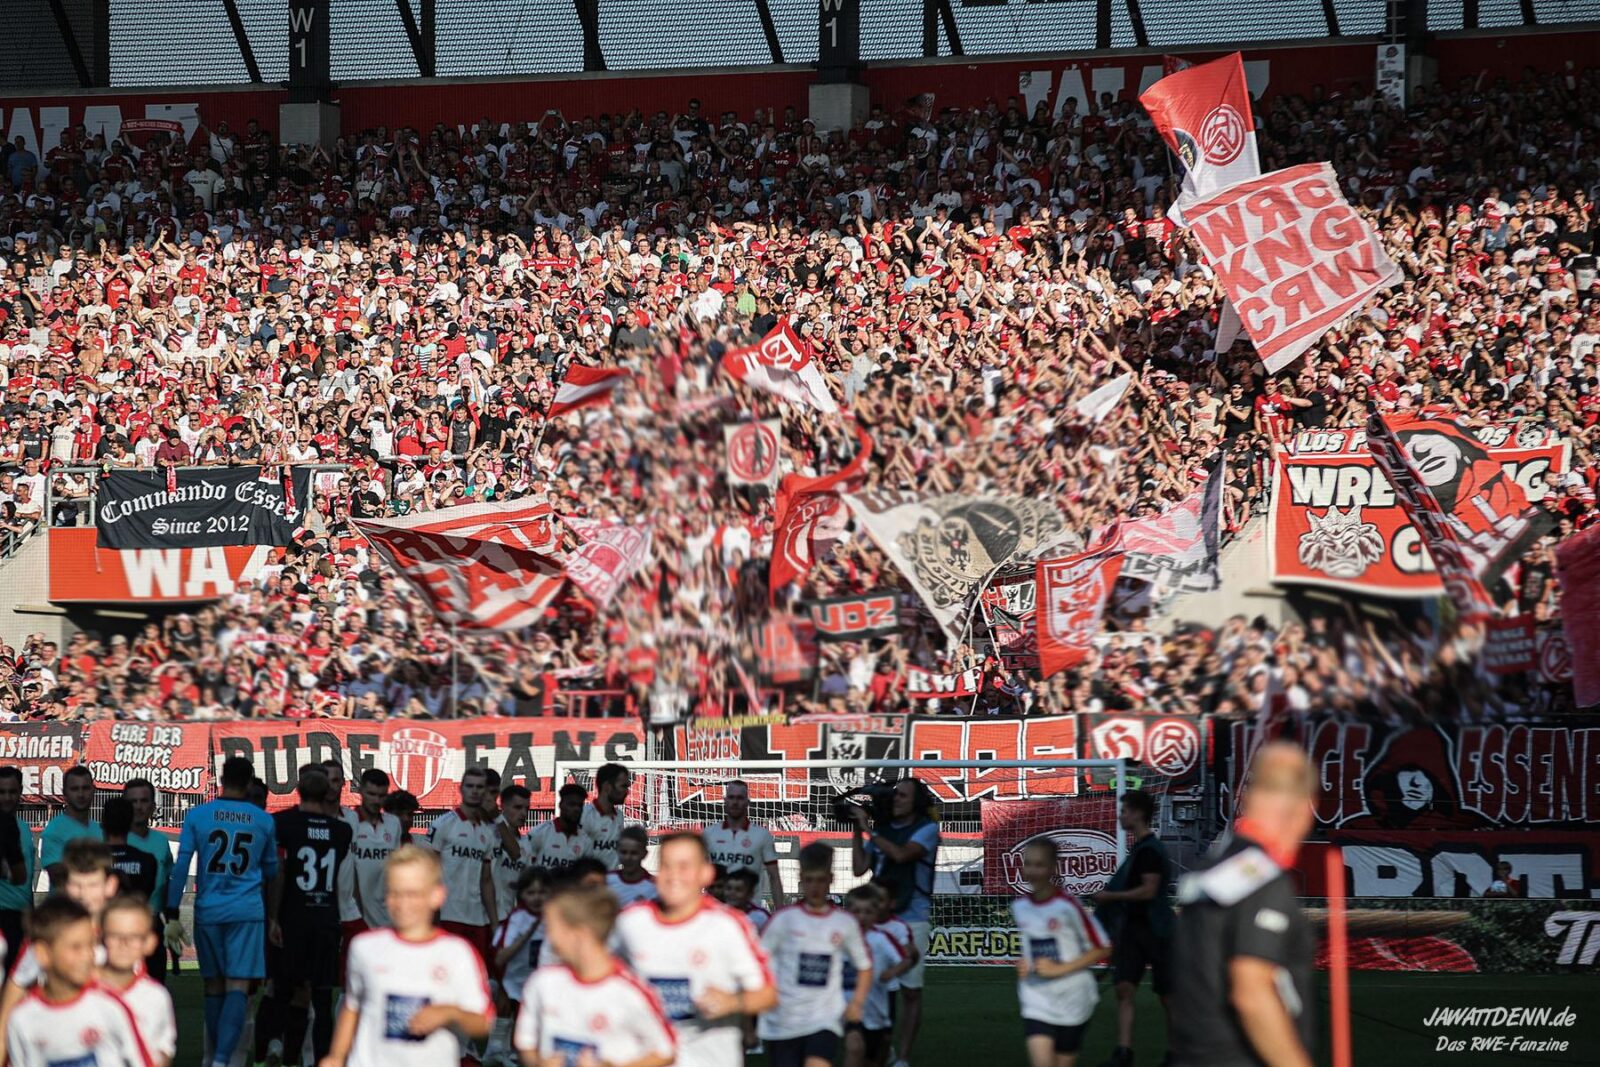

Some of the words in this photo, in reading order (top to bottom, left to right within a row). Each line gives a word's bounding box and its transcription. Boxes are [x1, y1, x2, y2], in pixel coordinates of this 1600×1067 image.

[289, 7, 315, 33] W
[825, 17, 837, 48] 1
[295, 38, 306, 68] 1
[151, 517, 201, 536] Since
[206, 515, 250, 534] 2012
[151, 726, 182, 747] DER
[207, 829, 252, 876] 25
[295, 845, 337, 892] 31
